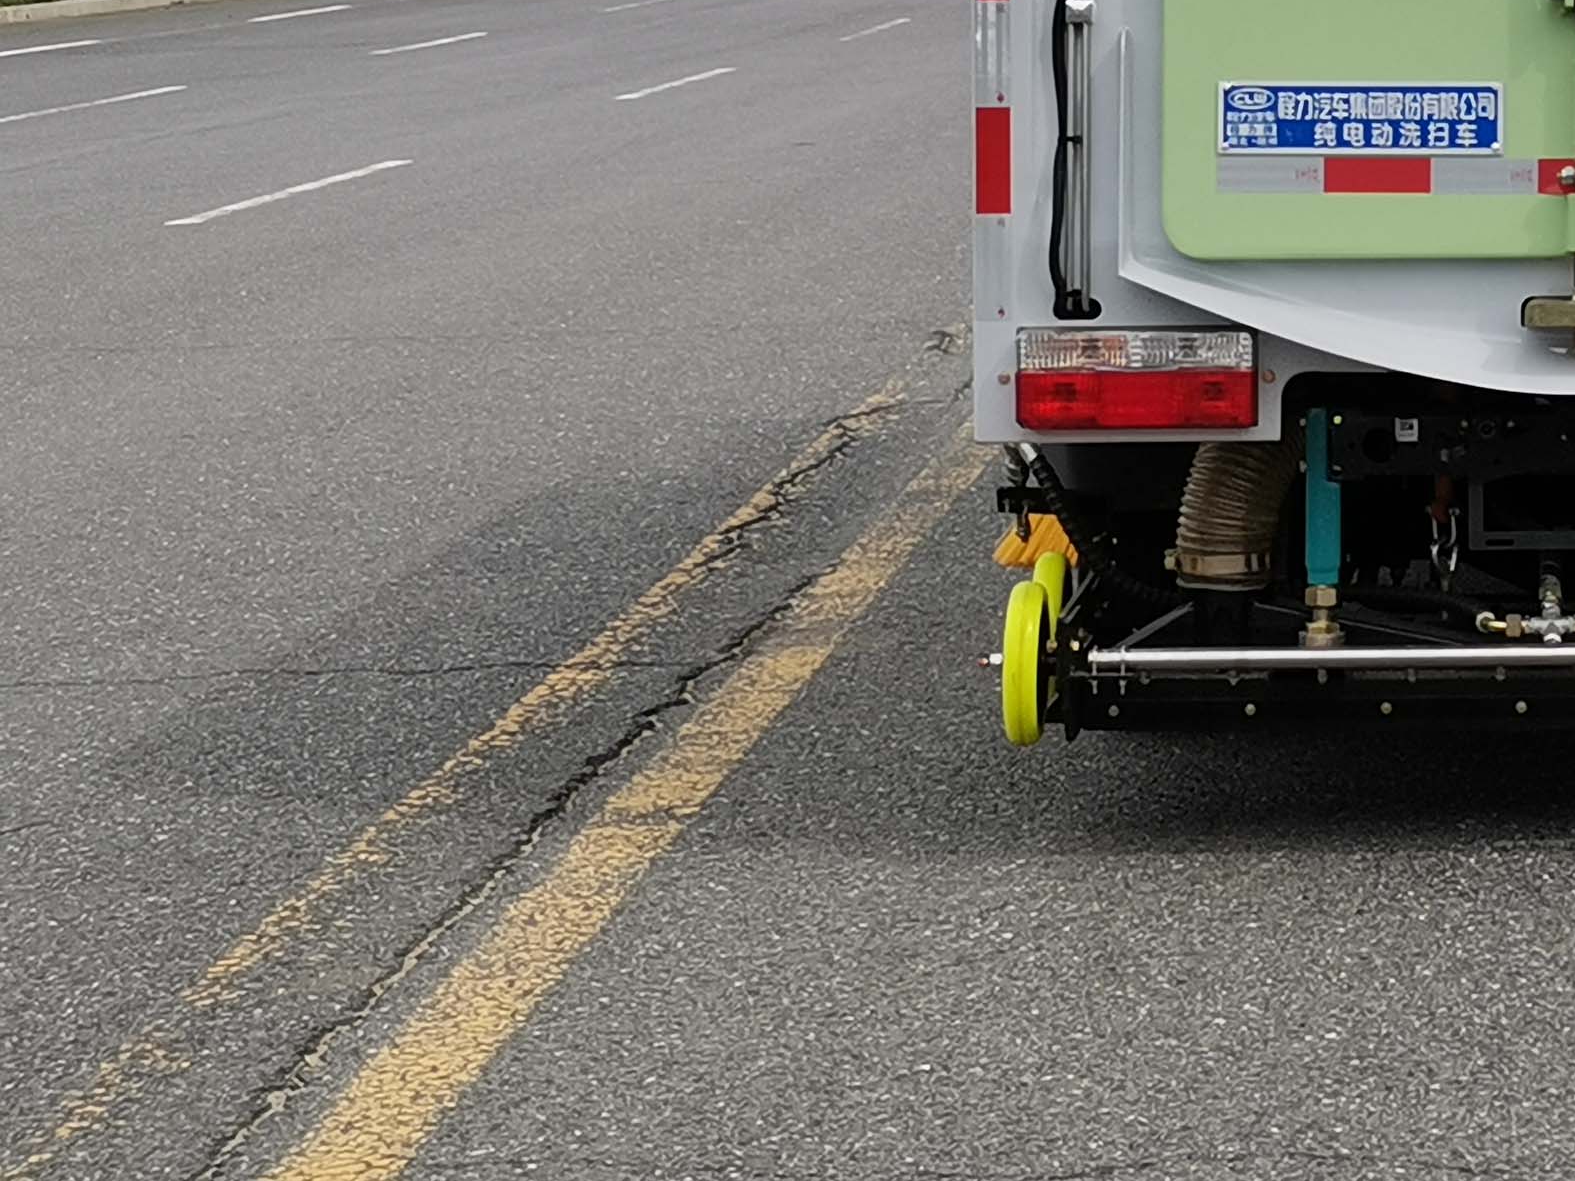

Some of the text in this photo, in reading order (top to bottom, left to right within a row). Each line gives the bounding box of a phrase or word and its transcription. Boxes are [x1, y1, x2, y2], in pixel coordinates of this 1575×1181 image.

[1313, 121, 1478, 147] 纯电动洗扫车
